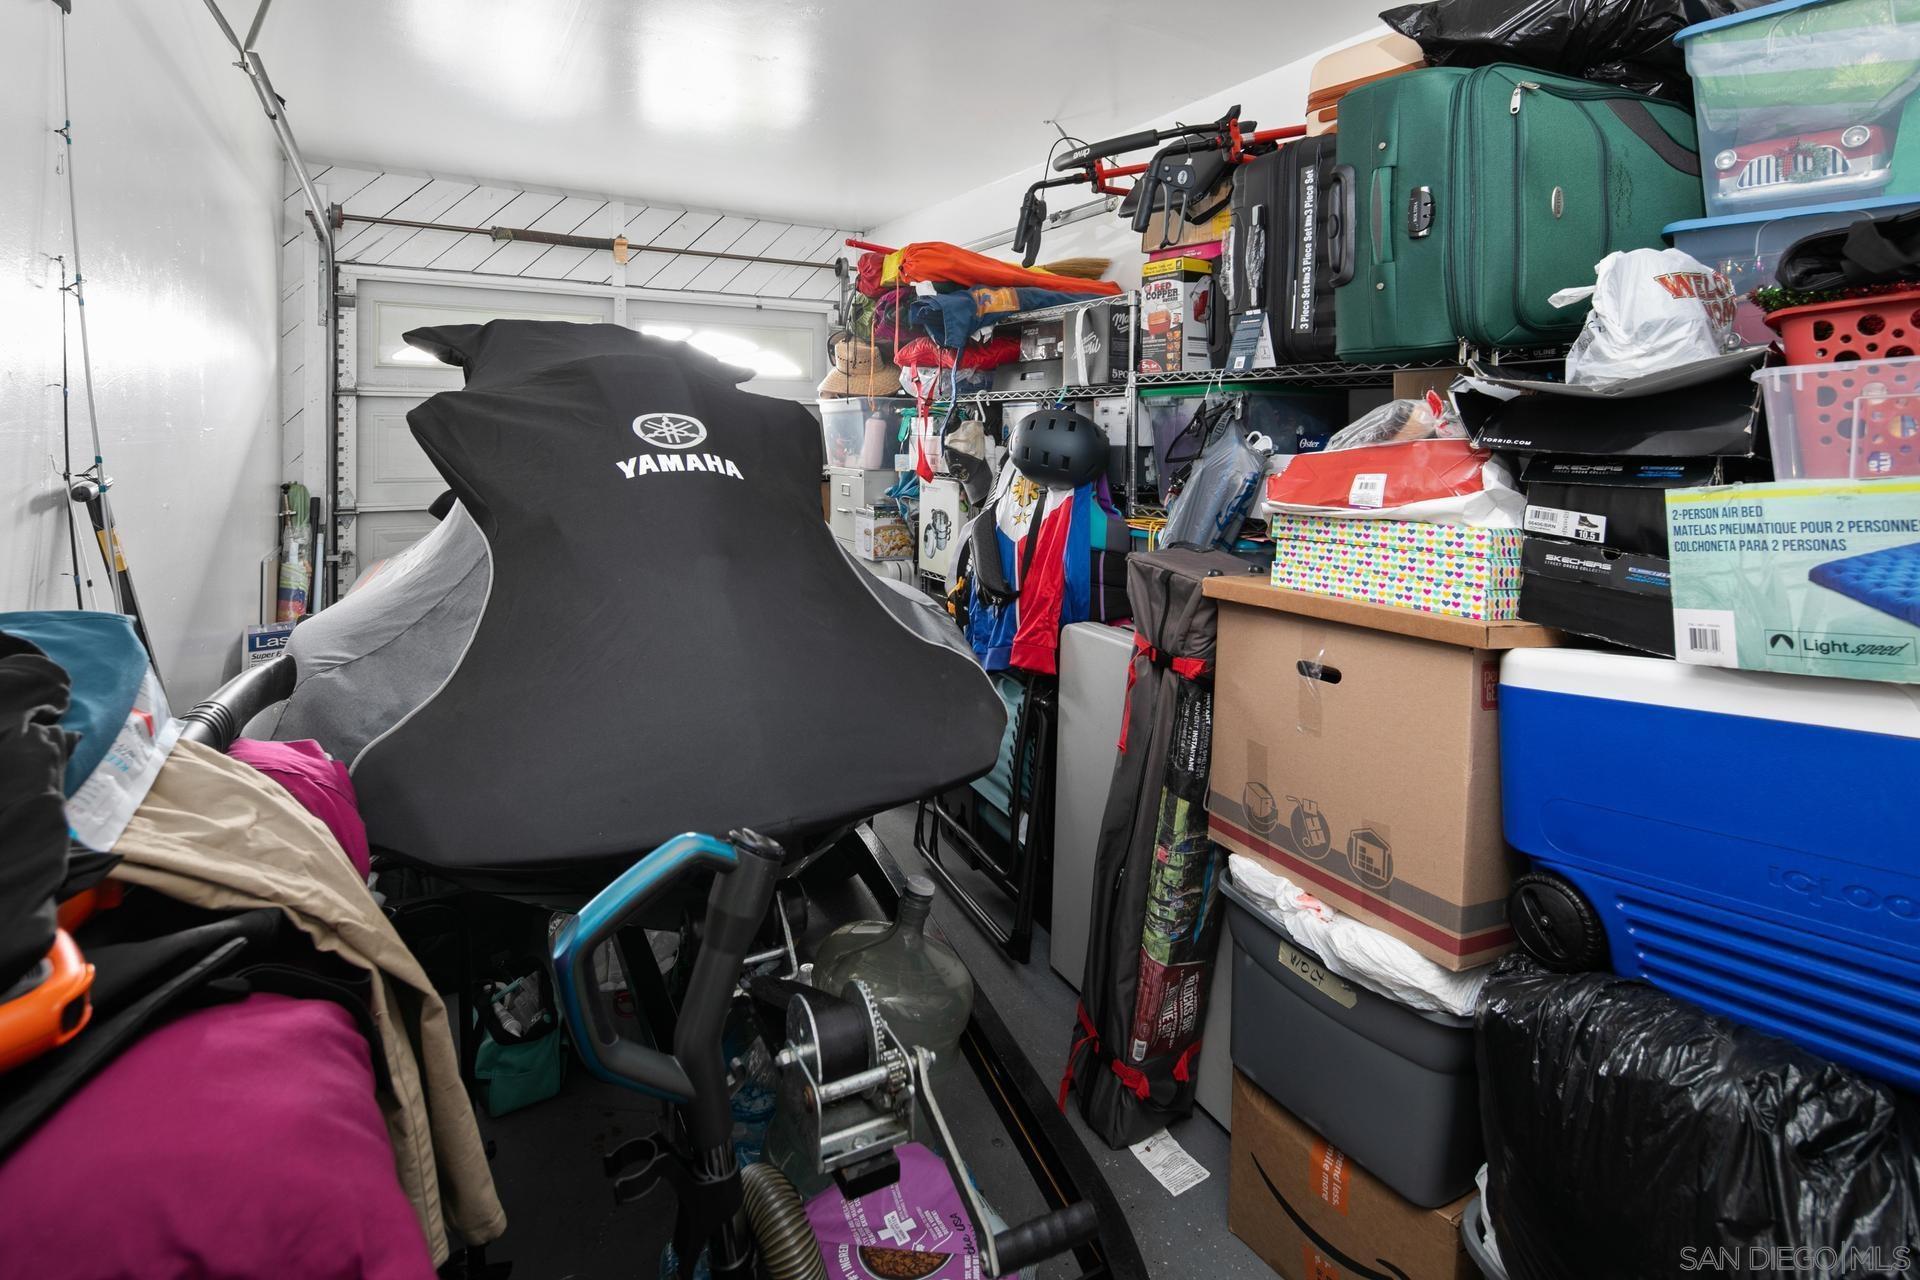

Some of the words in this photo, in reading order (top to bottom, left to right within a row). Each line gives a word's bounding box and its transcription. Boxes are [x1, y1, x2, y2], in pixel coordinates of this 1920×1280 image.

[1072, 147, 1090, 159] drive
[1304, 169, 1314, 184] Set
[1304, 185, 1314, 208] Piece
[1303, 228, 1313, 241] Set
[1303, 243, 1312, 265] Piece
[1154, 281, 1172, 292] RED
[1301, 285, 1311, 298] Set
[1146, 288, 1178, 301] COPPER
[1300, 297, 1310, 321] Piece
[1300, 321, 1309, 330] 3
[1300, 438, 1319, 448] Oster
[1482, 437, 1532, 446] TORRID.COM
[616, 453, 744, 480] YAMAHA
[1553, 464, 1624, 472] SKECHERS
[1672, 507, 1719, 521] 2-PERSON
[1721, 506, 1738, 518] AIR
[1741, 505, 1763, 518] BED
[1579, 530, 1596, 540] 10.5
[1673, 524, 1717, 536] MATELAS
[1719, 521, 1797, 535] PNEUMATIQUE
[1800, 521, 1832, 534] POUR
[1836, 520, 1844, 533] 2
[1848, 519, 1920, 533] PERSONNE
[1674, 539, 1736, 553] COLCHONETA
[1739, 539, 1768, 551] PARA
[1772, 540, 1779, 551] 2
[1782, 538, 1847, 551] PERSONAS
[1545, 554, 1612, 570] SKECHERS
[256, 636, 289, 648] Las
[251, 652, 274, 661] Super
[1192, 701, 1200, 728] AUVENT
[1204, 692, 1212, 725] INSTANT
[1183, 974, 1196, 1016] BLOCKS
[1323, 1144, 1334, 1171] mile
[1333, 1150, 1344, 1184] pend
[950, 1212, 966, 1232] USA
